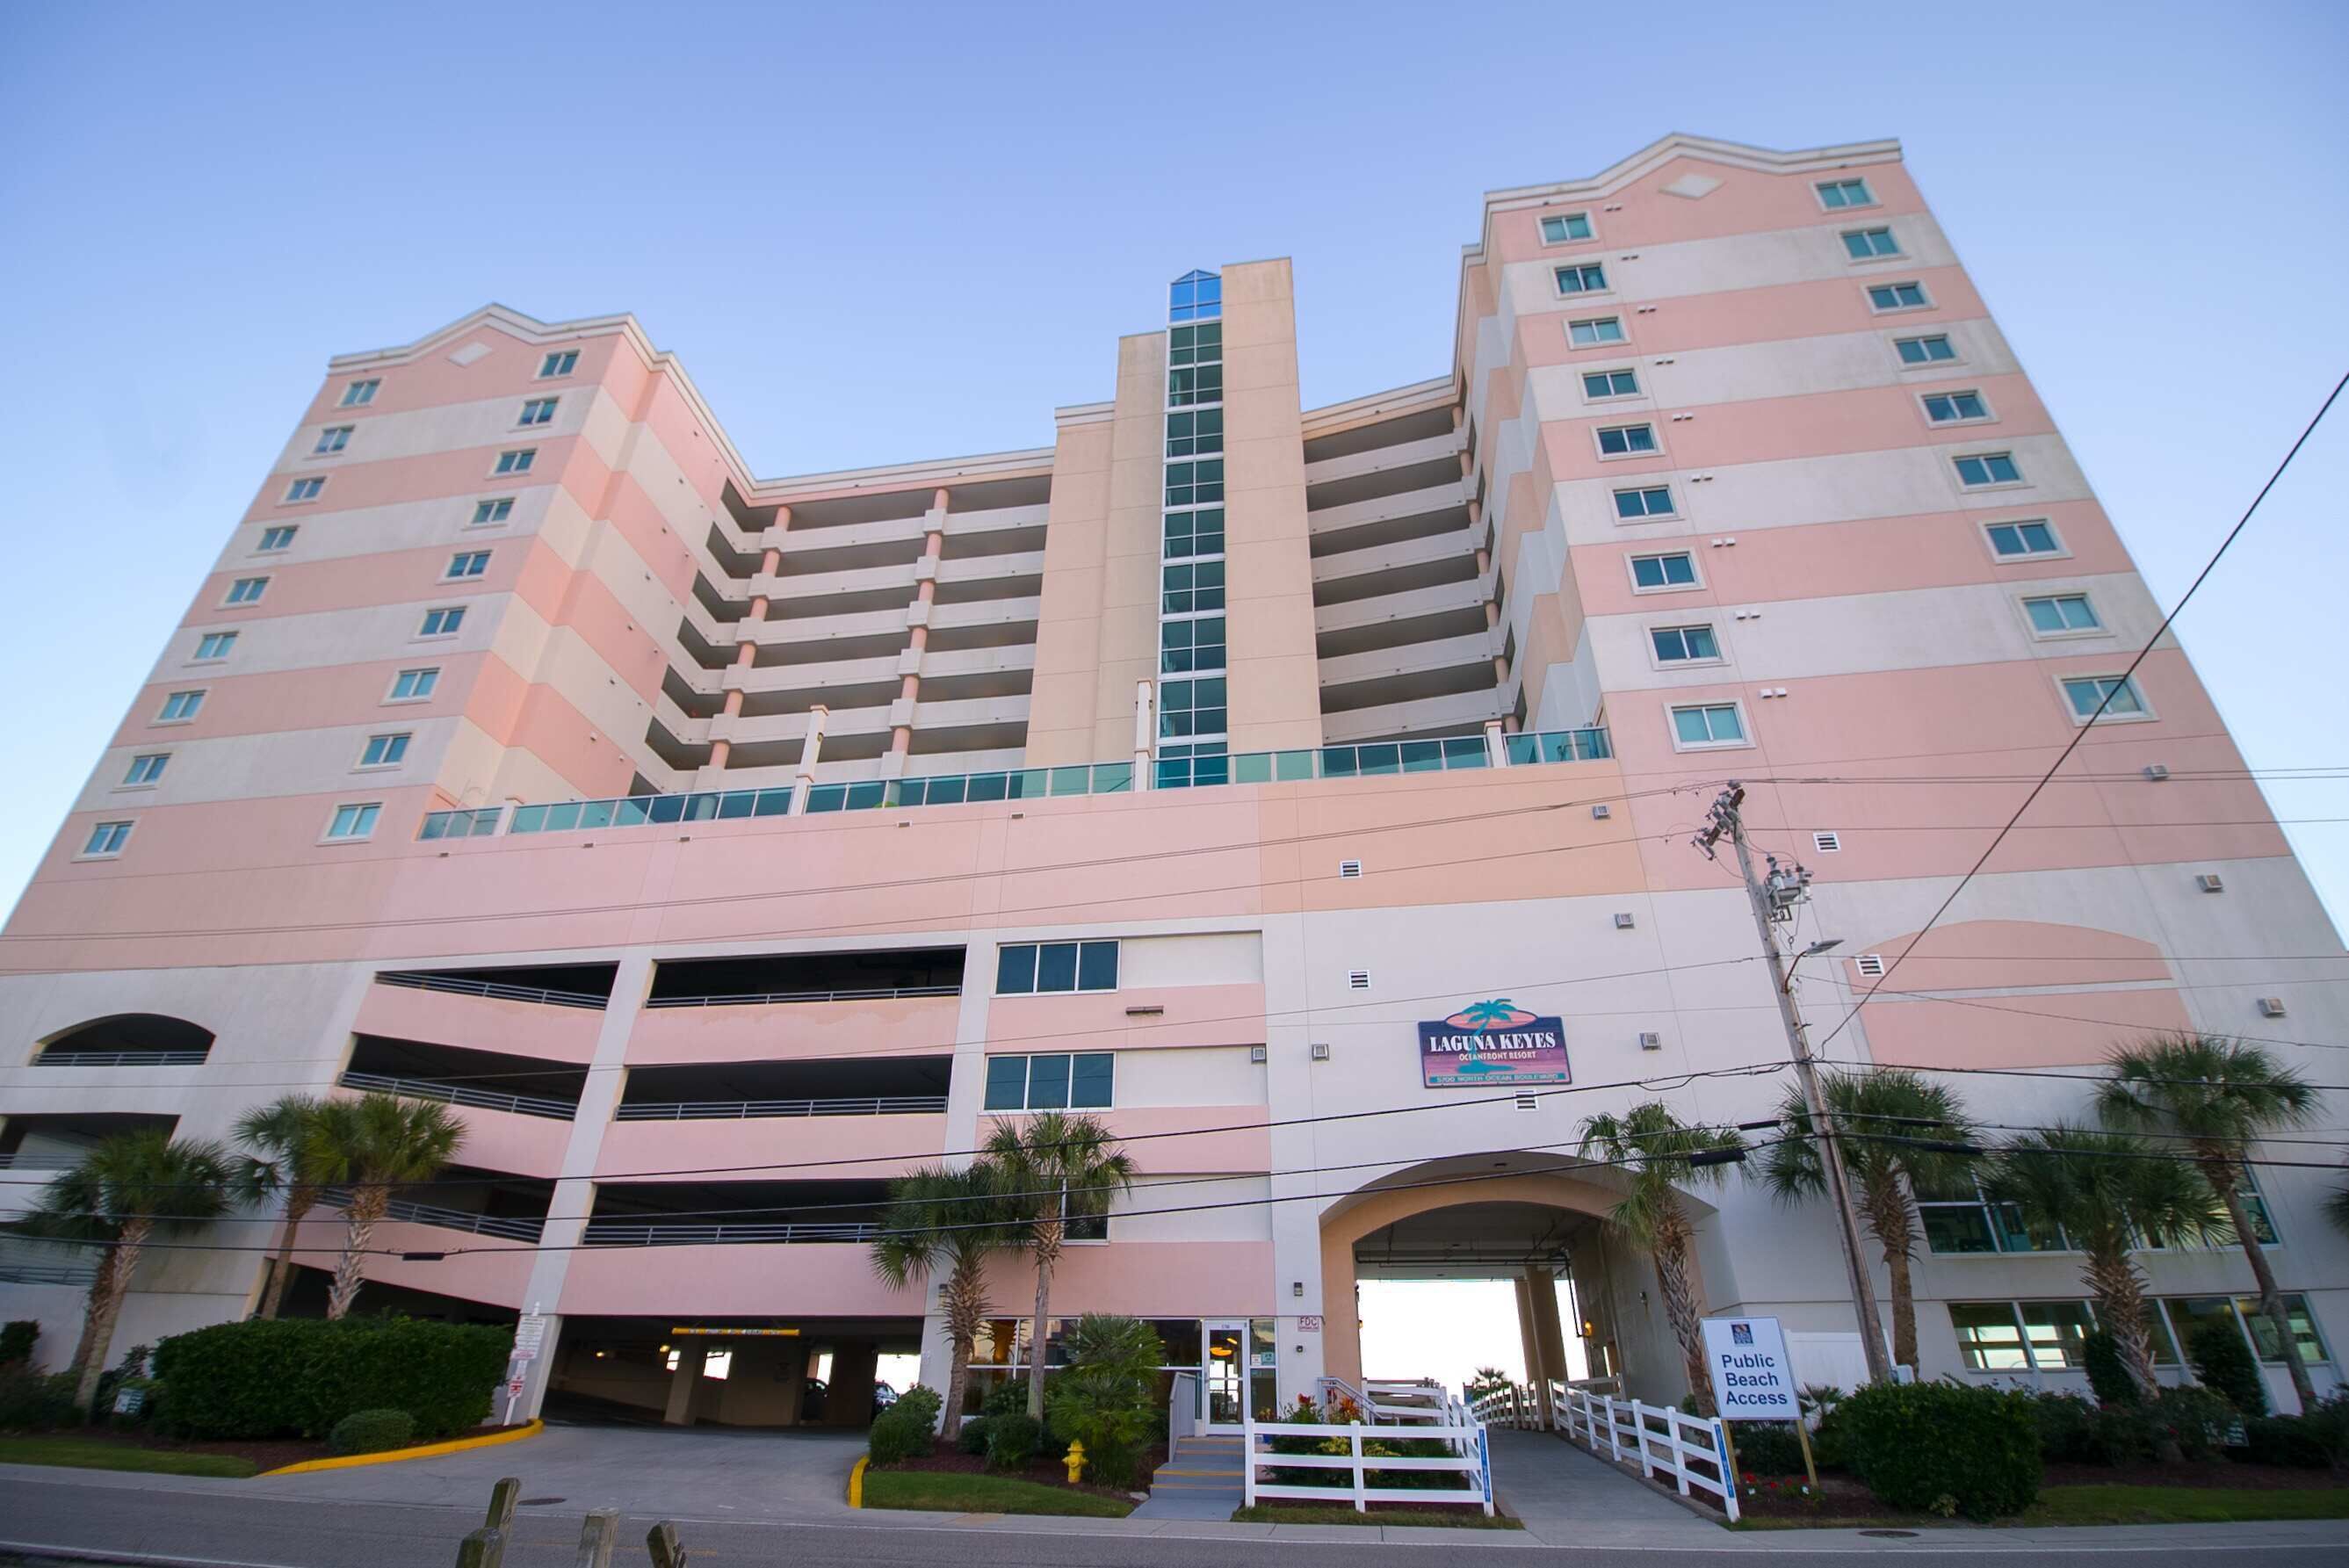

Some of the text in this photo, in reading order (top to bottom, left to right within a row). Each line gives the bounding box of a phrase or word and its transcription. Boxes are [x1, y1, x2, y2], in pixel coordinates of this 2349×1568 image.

[1430, 1032, 1556, 1052] LAGUNA KEYES
[1459, 1051, 1536, 1061] OCEANFRONT RESORT
[1300, 1316, 1317, 1326] FDC
[1722, 1354, 1774, 1368] Public
[1725, 1372, 1779, 1386] Beach
[1726, 1391, 1788, 1405] Access
